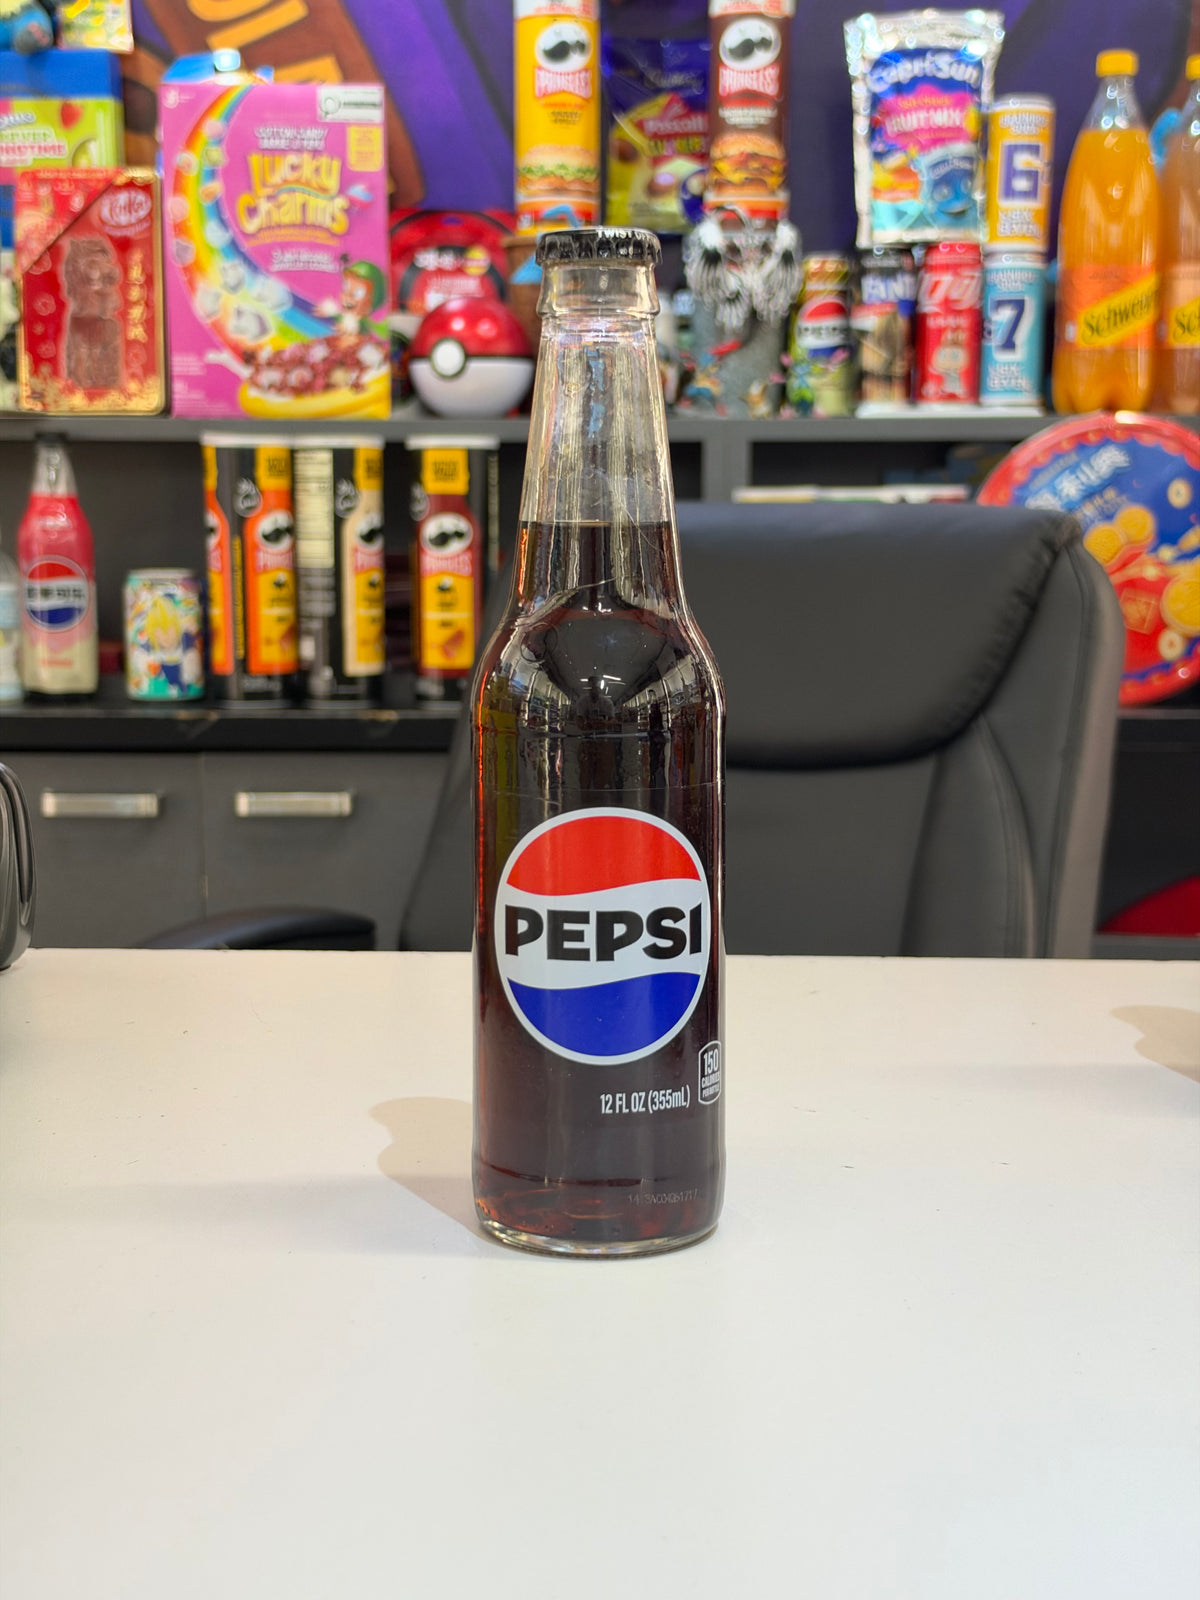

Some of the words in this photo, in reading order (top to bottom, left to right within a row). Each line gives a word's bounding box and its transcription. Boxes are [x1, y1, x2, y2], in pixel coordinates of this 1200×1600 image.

[248, 152, 341, 199] Lucky
[1001, 142, 1041, 202] 6
[237, 190, 349, 235] Charms
[988, 296, 1029, 354] 7
[505, 902, 703, 962] PEPSI
[703, 1048, 719, 1075] 150
[600, 1093, 613, 1114] 12
[615, 1092, 629, 1114] FL
[631, 1090, 646, 1113] OZ
[648, 1084, 691, 1114] (355mL)
